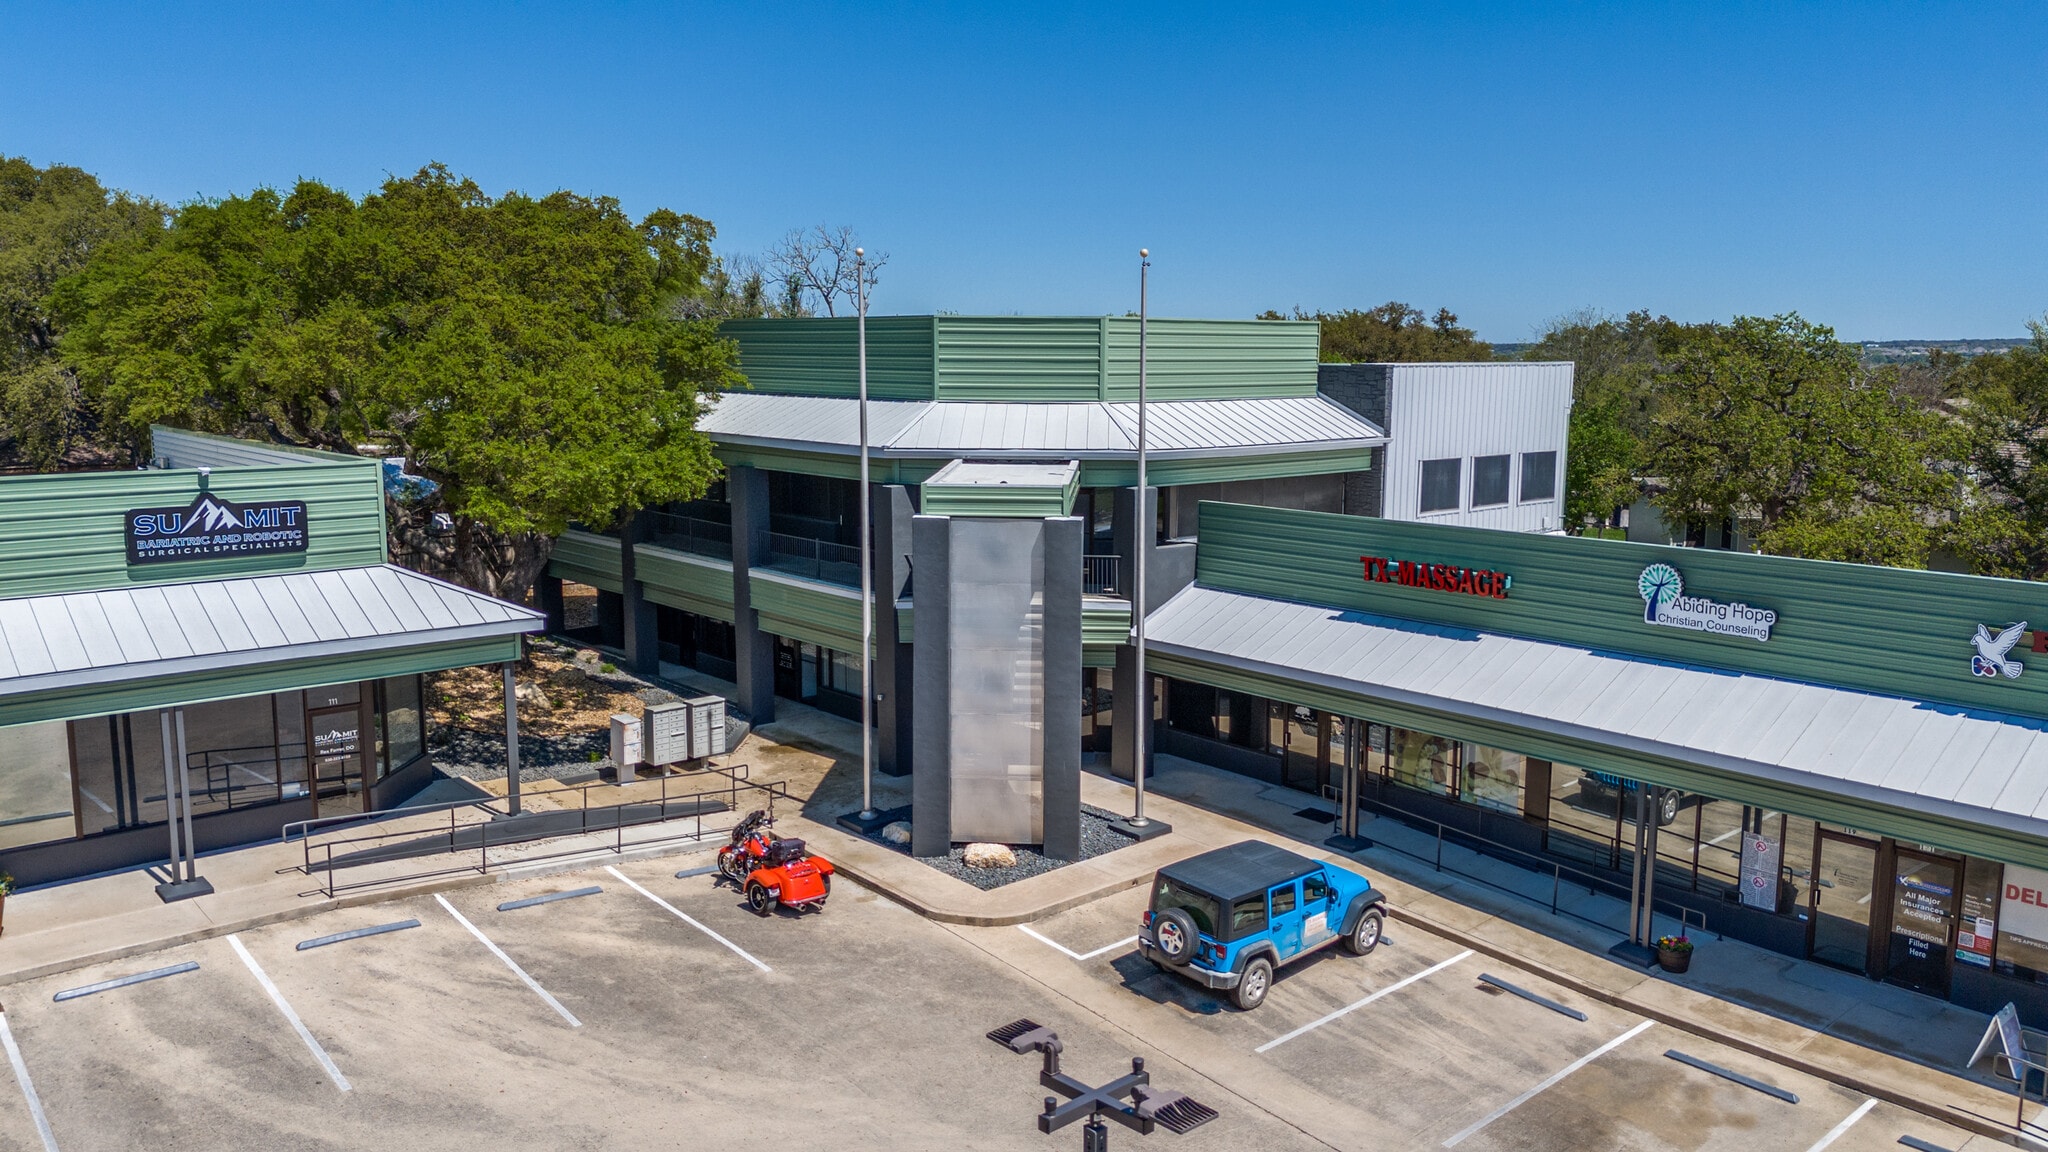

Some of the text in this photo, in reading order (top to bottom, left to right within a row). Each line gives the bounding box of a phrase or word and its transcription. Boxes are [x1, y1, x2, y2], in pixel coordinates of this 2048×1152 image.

[136, 530, 303, 550] BARIATRIC AND ROBOTIC
[138, 540, 303, 558] SURGICAL SPECIALISTS
[1360, 556, 1508, 599] TX-MASSAGE
[1671, 597, 1774, 624] Abiding Hope
[1658, 613, 1767, 639] Christian Counseling
[1900, 898, 1944, 915] Insurances
[1905, 891, 1941, 906] All Major
[1903, 908, 1942, 923] Accepted
[1895, 925, 1944, 944] Prescriptions
[1908, 937, 1929, 950] Filled
[1909, 947, 1927, 959] Here
